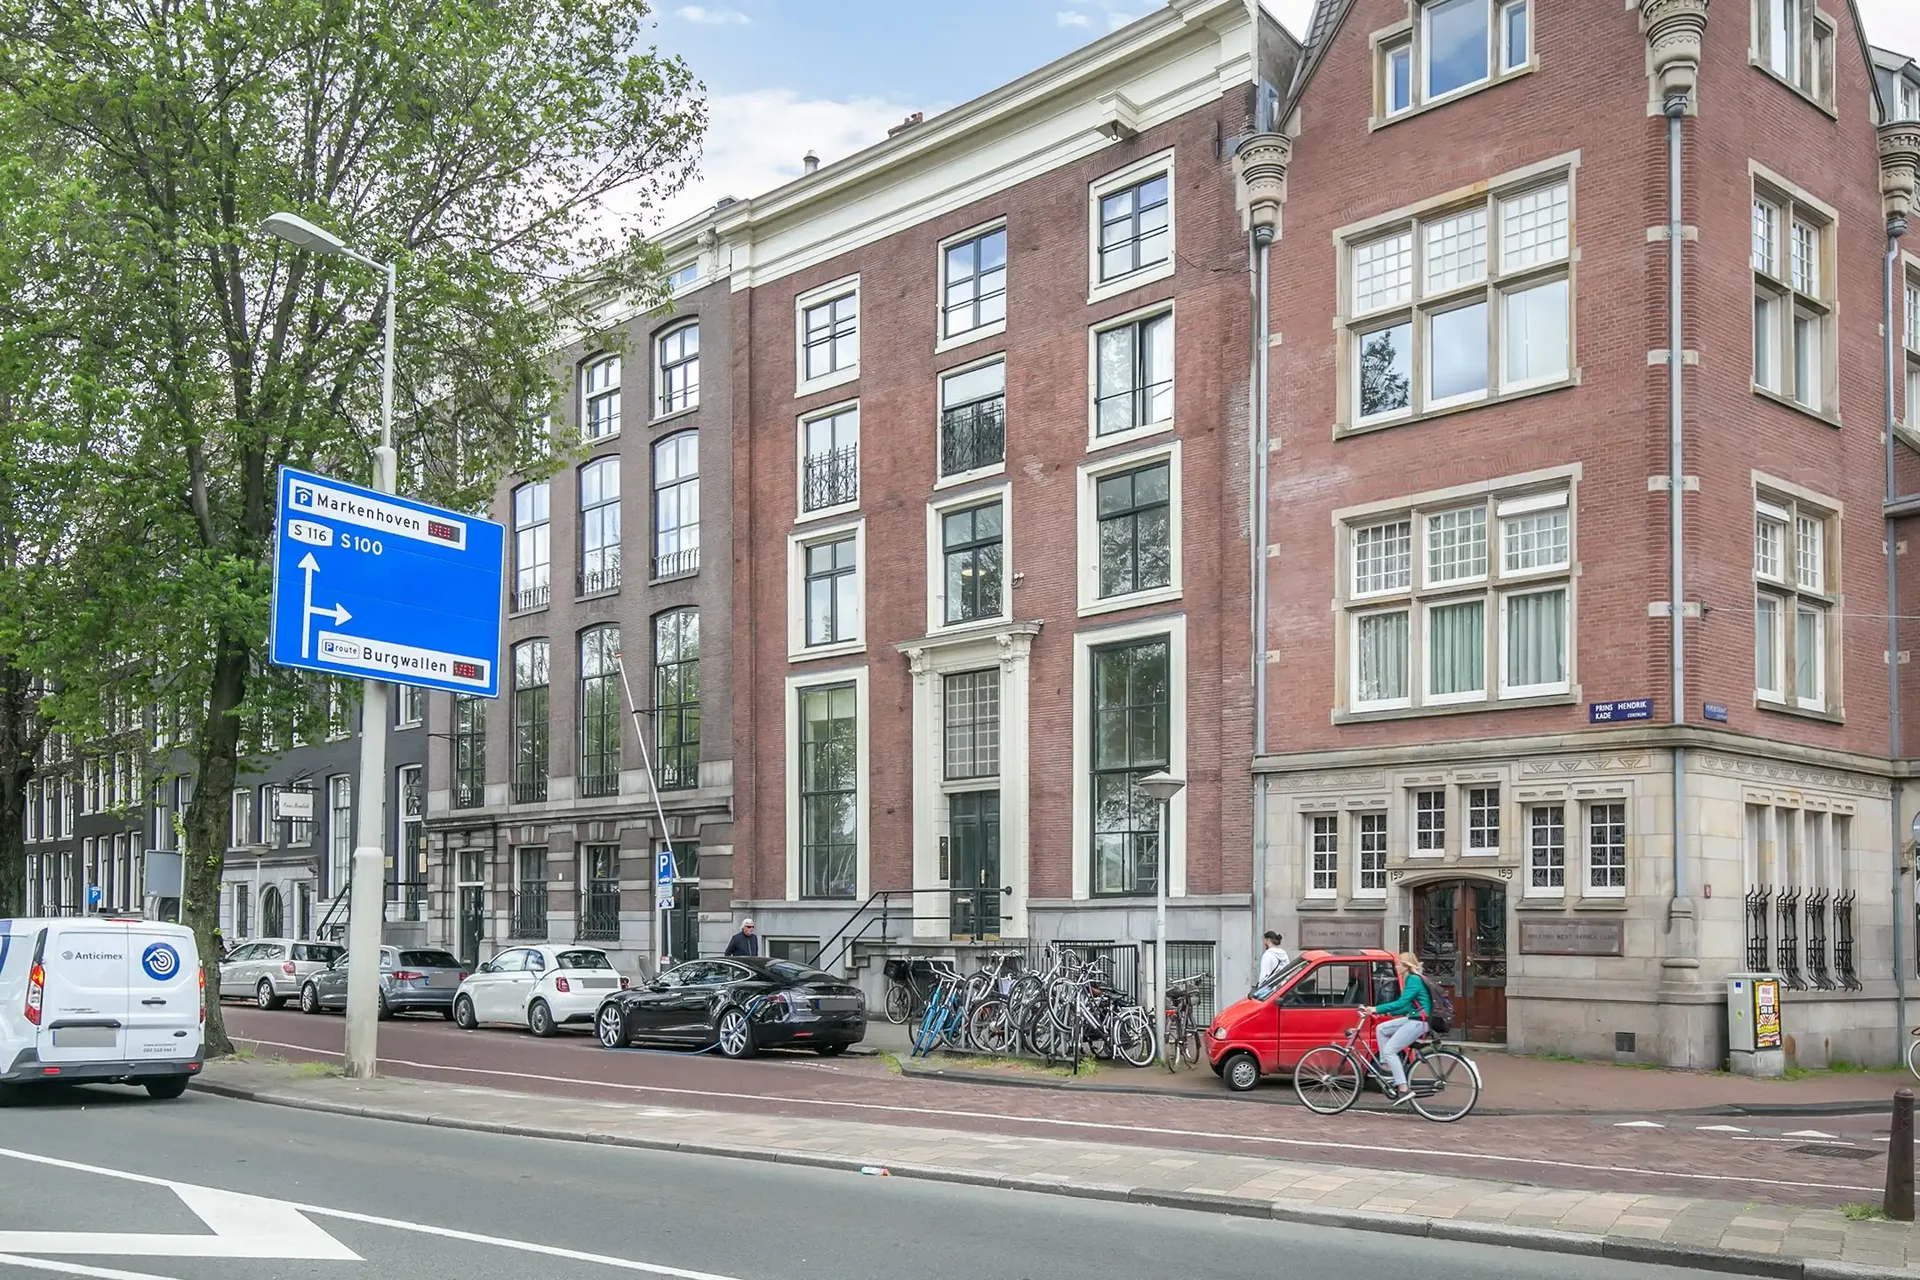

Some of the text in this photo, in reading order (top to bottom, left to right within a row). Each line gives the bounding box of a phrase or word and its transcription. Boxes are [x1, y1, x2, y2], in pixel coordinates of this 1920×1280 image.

[317, 493, 420, 531] Markenhoven
[308, 526, 327, 541] 116
[335, 644, 358, 655] route
[363, 647, 447, 674] Burgwallen
[1595, 701, 1647, 712] PRINS HENDRIK
[1595, 712, 1611, 720] KADE
[660, 855, 669, 872] P
[1390, 870, 1404, 882] 159
[1498, 868, 1513, 879] 159
[75, 951, 123, 961] Anticimex
